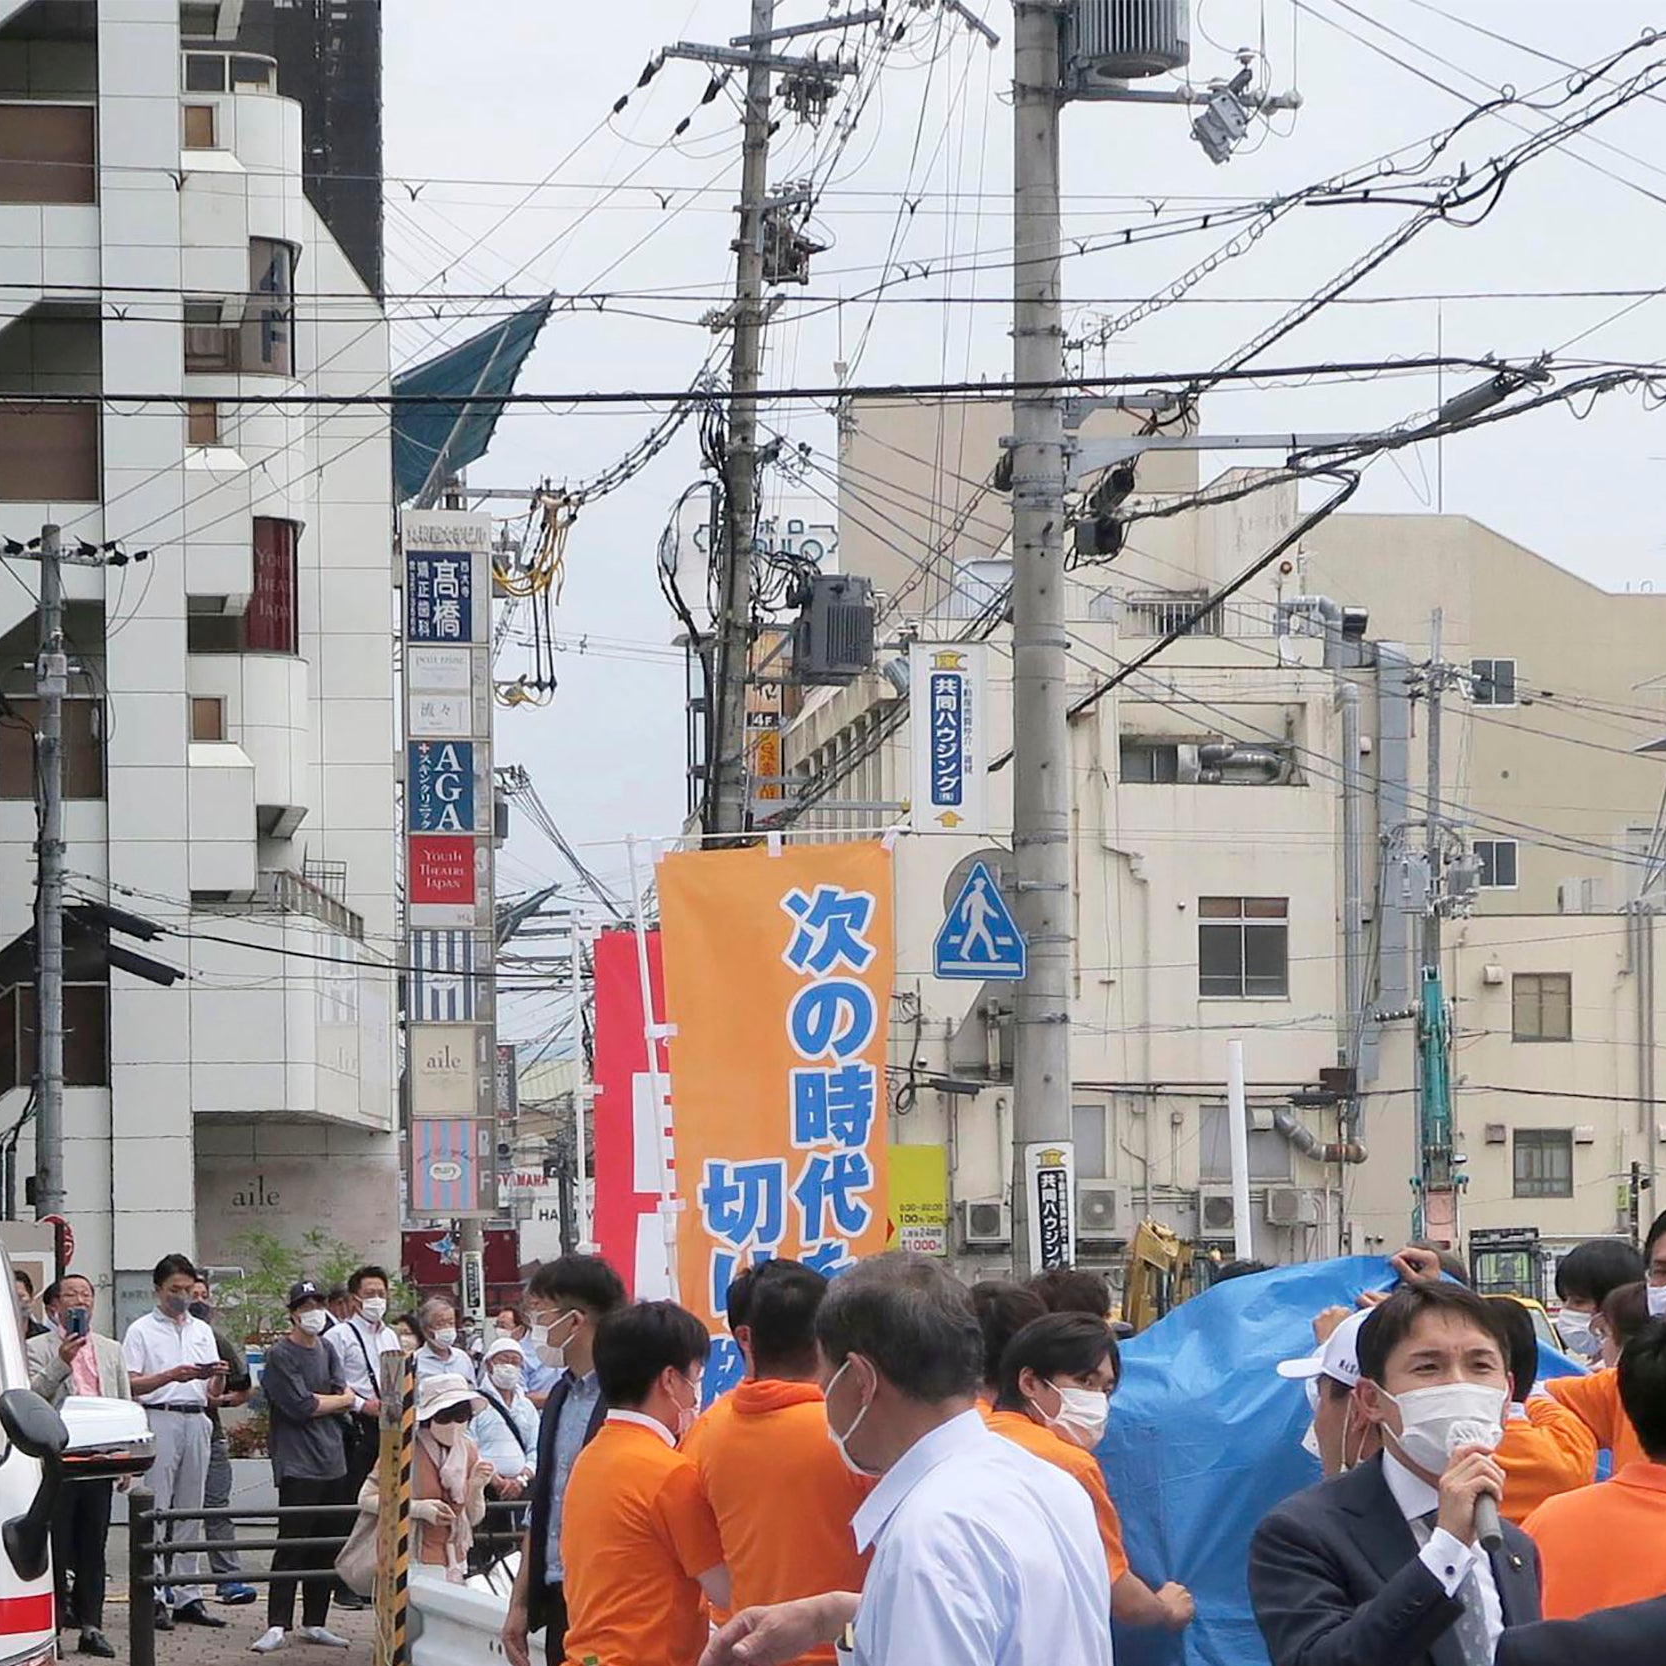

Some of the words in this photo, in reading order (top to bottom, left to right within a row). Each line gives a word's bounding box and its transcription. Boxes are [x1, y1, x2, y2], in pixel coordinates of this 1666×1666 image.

[434, 743, 465, 831] AGA
[427, 1045, 462, 1069] aile
[232, 1175, 281, 1207] aile
